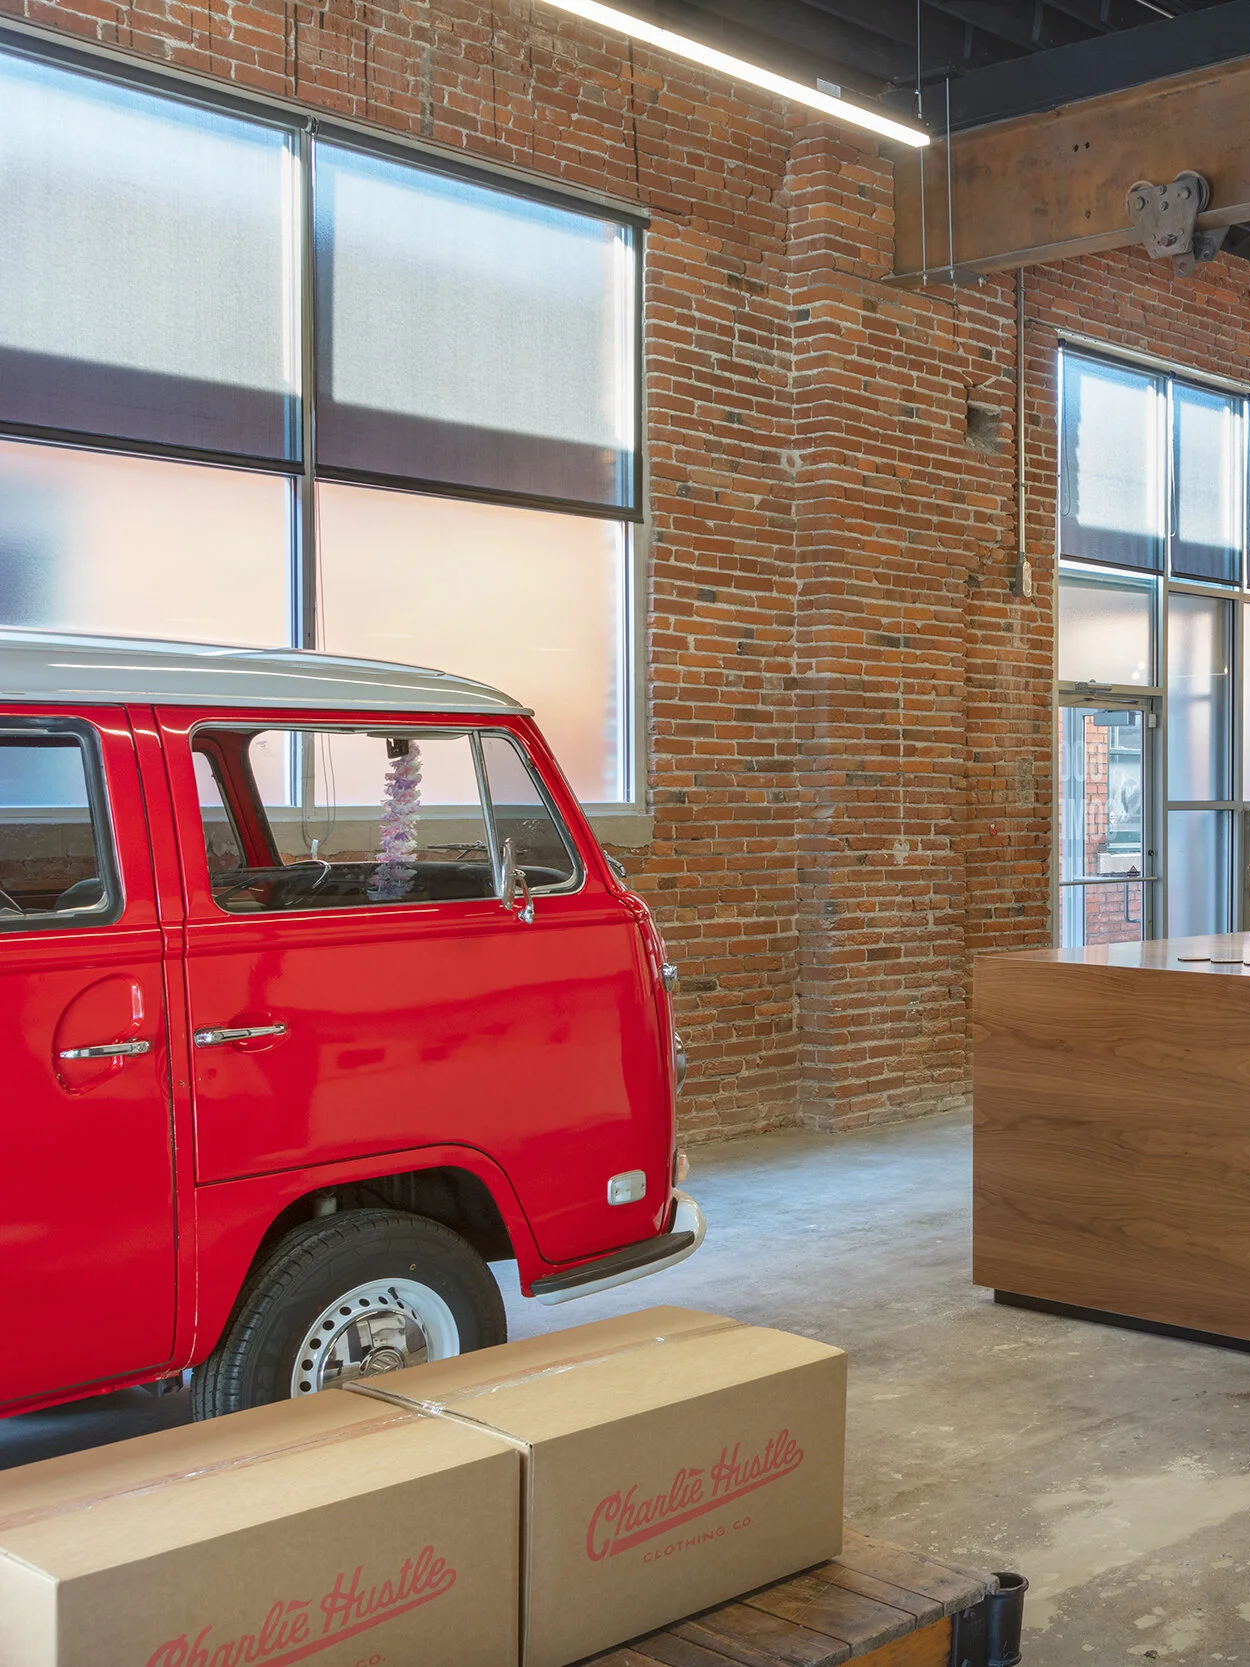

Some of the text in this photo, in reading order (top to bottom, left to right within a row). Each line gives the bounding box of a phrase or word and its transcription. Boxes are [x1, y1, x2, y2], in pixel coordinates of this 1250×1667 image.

[586, 1428, 804, 1562] Charlie Hustle
[643, 1516, 755, 1563] CLOTHING CO.
[320, 1545, 457, 1635] Hustle
